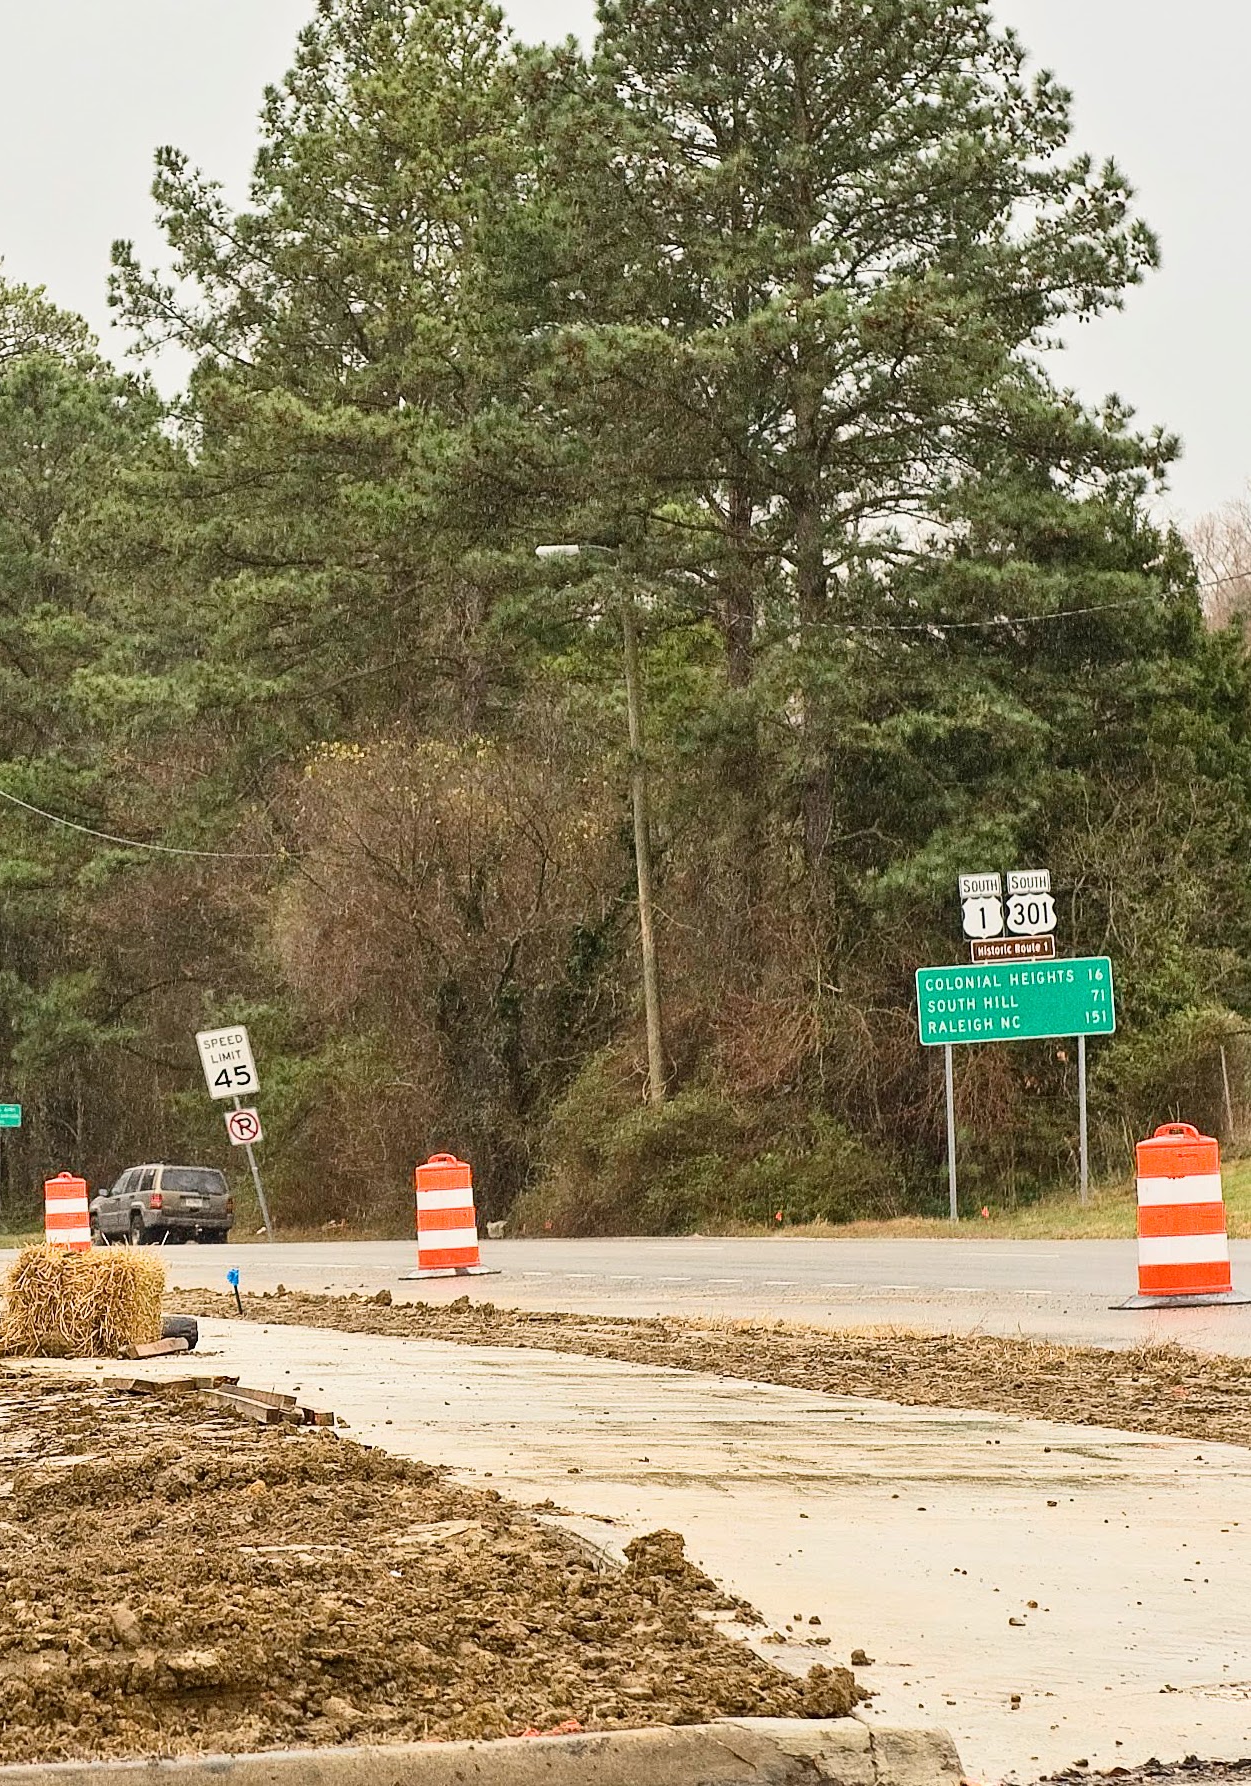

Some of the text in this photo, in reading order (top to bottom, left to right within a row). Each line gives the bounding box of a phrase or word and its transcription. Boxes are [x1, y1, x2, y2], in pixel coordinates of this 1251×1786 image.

[963, 879, 998, 893] SOUTH
[1011, 876, 1047, 890] SOUTH
[979, 907, 987, 929] 1
[1013, 902, 1049, 925] 301
[977, 942, 1048, 957] Historic Route 1
[925, 969, 1103, 992] COLONIAL HEIGHTS 16
[927, 989, 1105, 1014] SOUTH HILL 71
[928, 1011, 1107, 1035] RALEIGH NC 151
[203, 1034, 243, 1050] SPEED
[210, 1050, 241, 1064] LIMIT
[214, 1065, 251, 1088] 45
